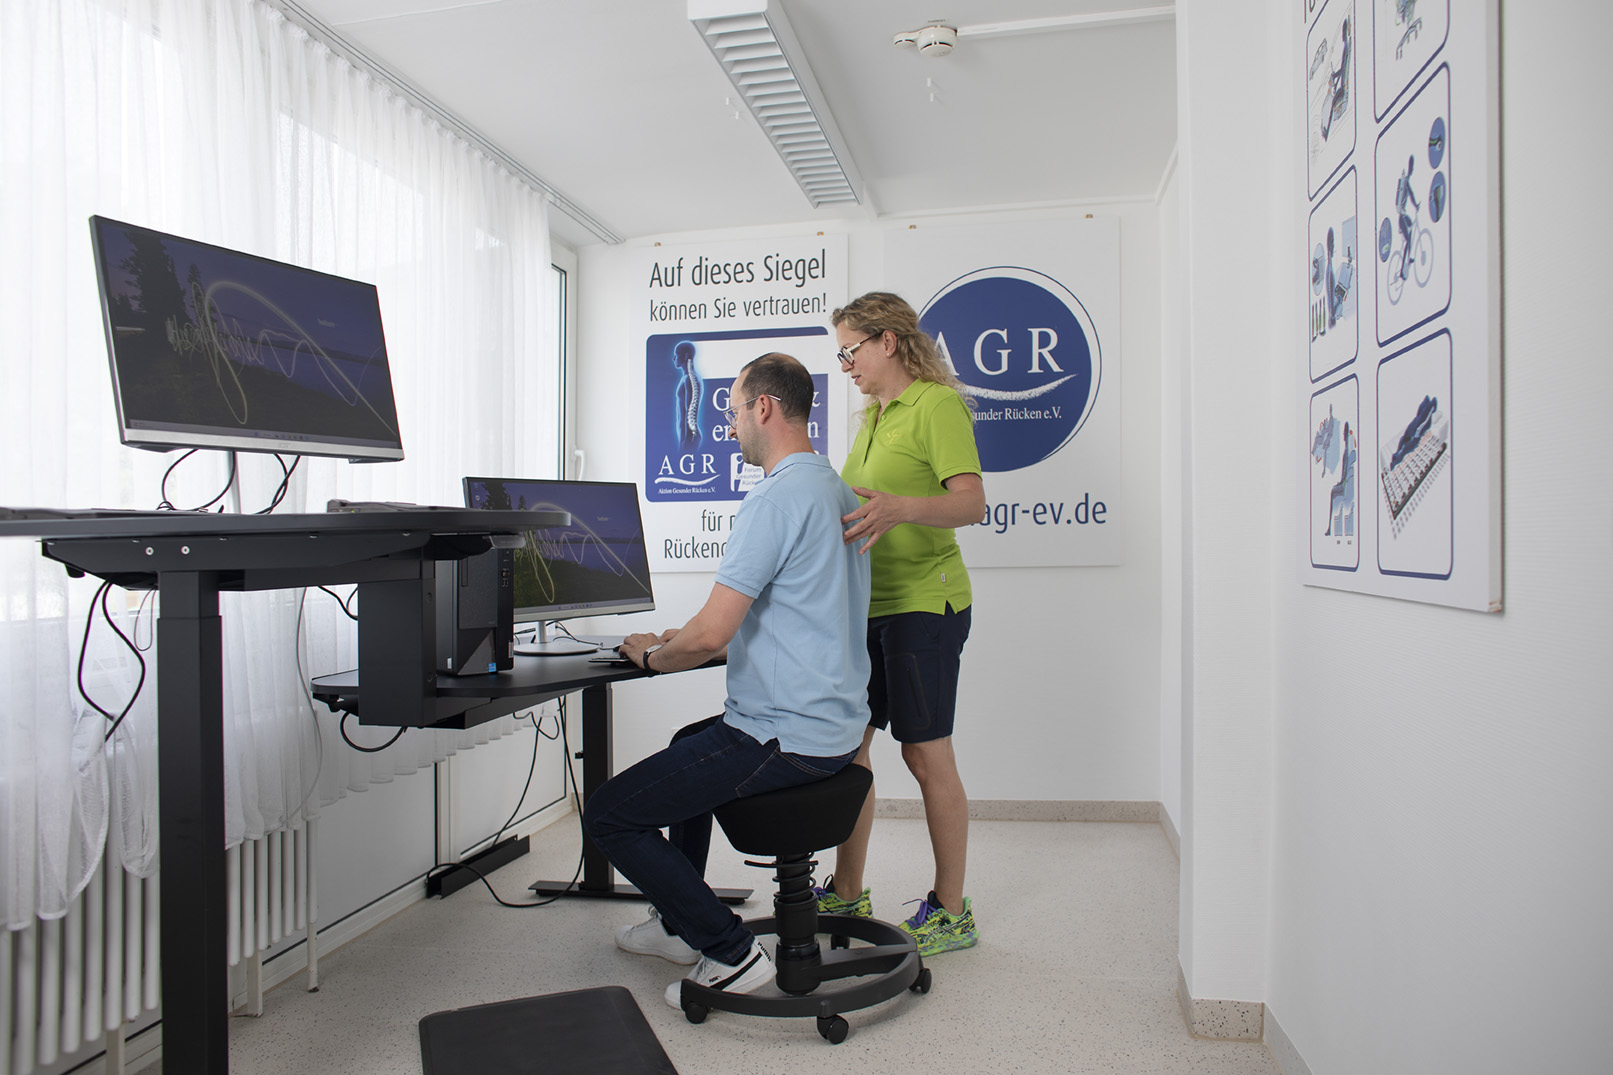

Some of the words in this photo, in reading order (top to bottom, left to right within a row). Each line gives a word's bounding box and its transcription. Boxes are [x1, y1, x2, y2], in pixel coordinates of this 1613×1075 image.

[649, 257, 684, 288] Auf
[691, 256, 755, 286] dieses
[763, 248, 826, 288] Siegel
[650, 299, 707, 322] können
[714, 297, 737, 319] Sie
[743, 292, 827, 317] vertrauen!
[972, 408, 1004, 421] under
[1004, 407, 1042, 420] Rücken
[1043, 406, 1062, 419] e.V.
[701, 509, 723, 532] für
[970, 492, 1107, 534] agr-ev.de
